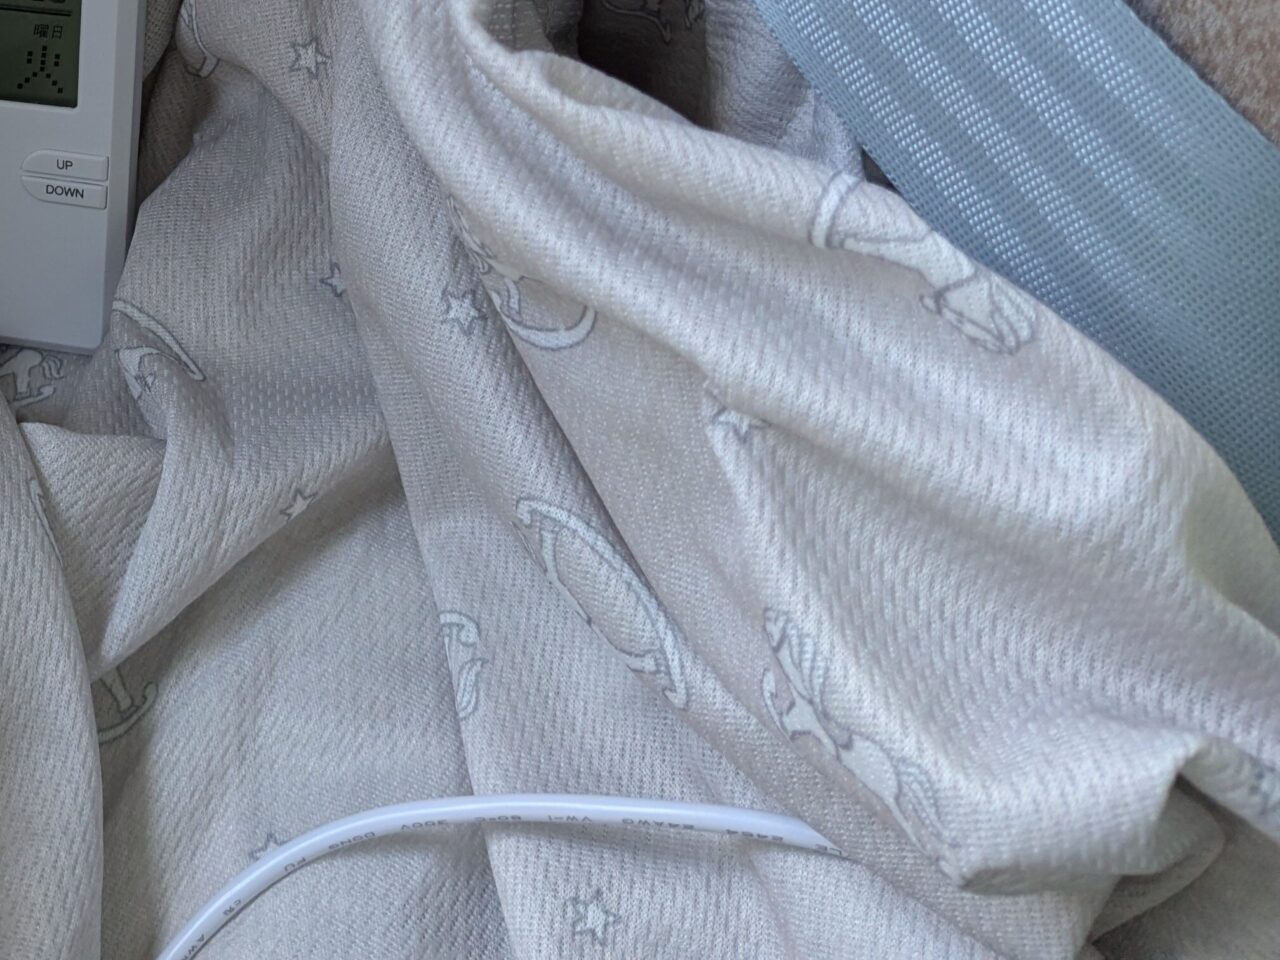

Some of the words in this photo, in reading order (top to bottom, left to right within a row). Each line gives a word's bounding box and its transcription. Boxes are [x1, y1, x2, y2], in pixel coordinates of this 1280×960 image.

[32, 23, 64, 39] 曜日
[56, 159, 74, 171] UP
[45, 183, 85, 200] DOWN
